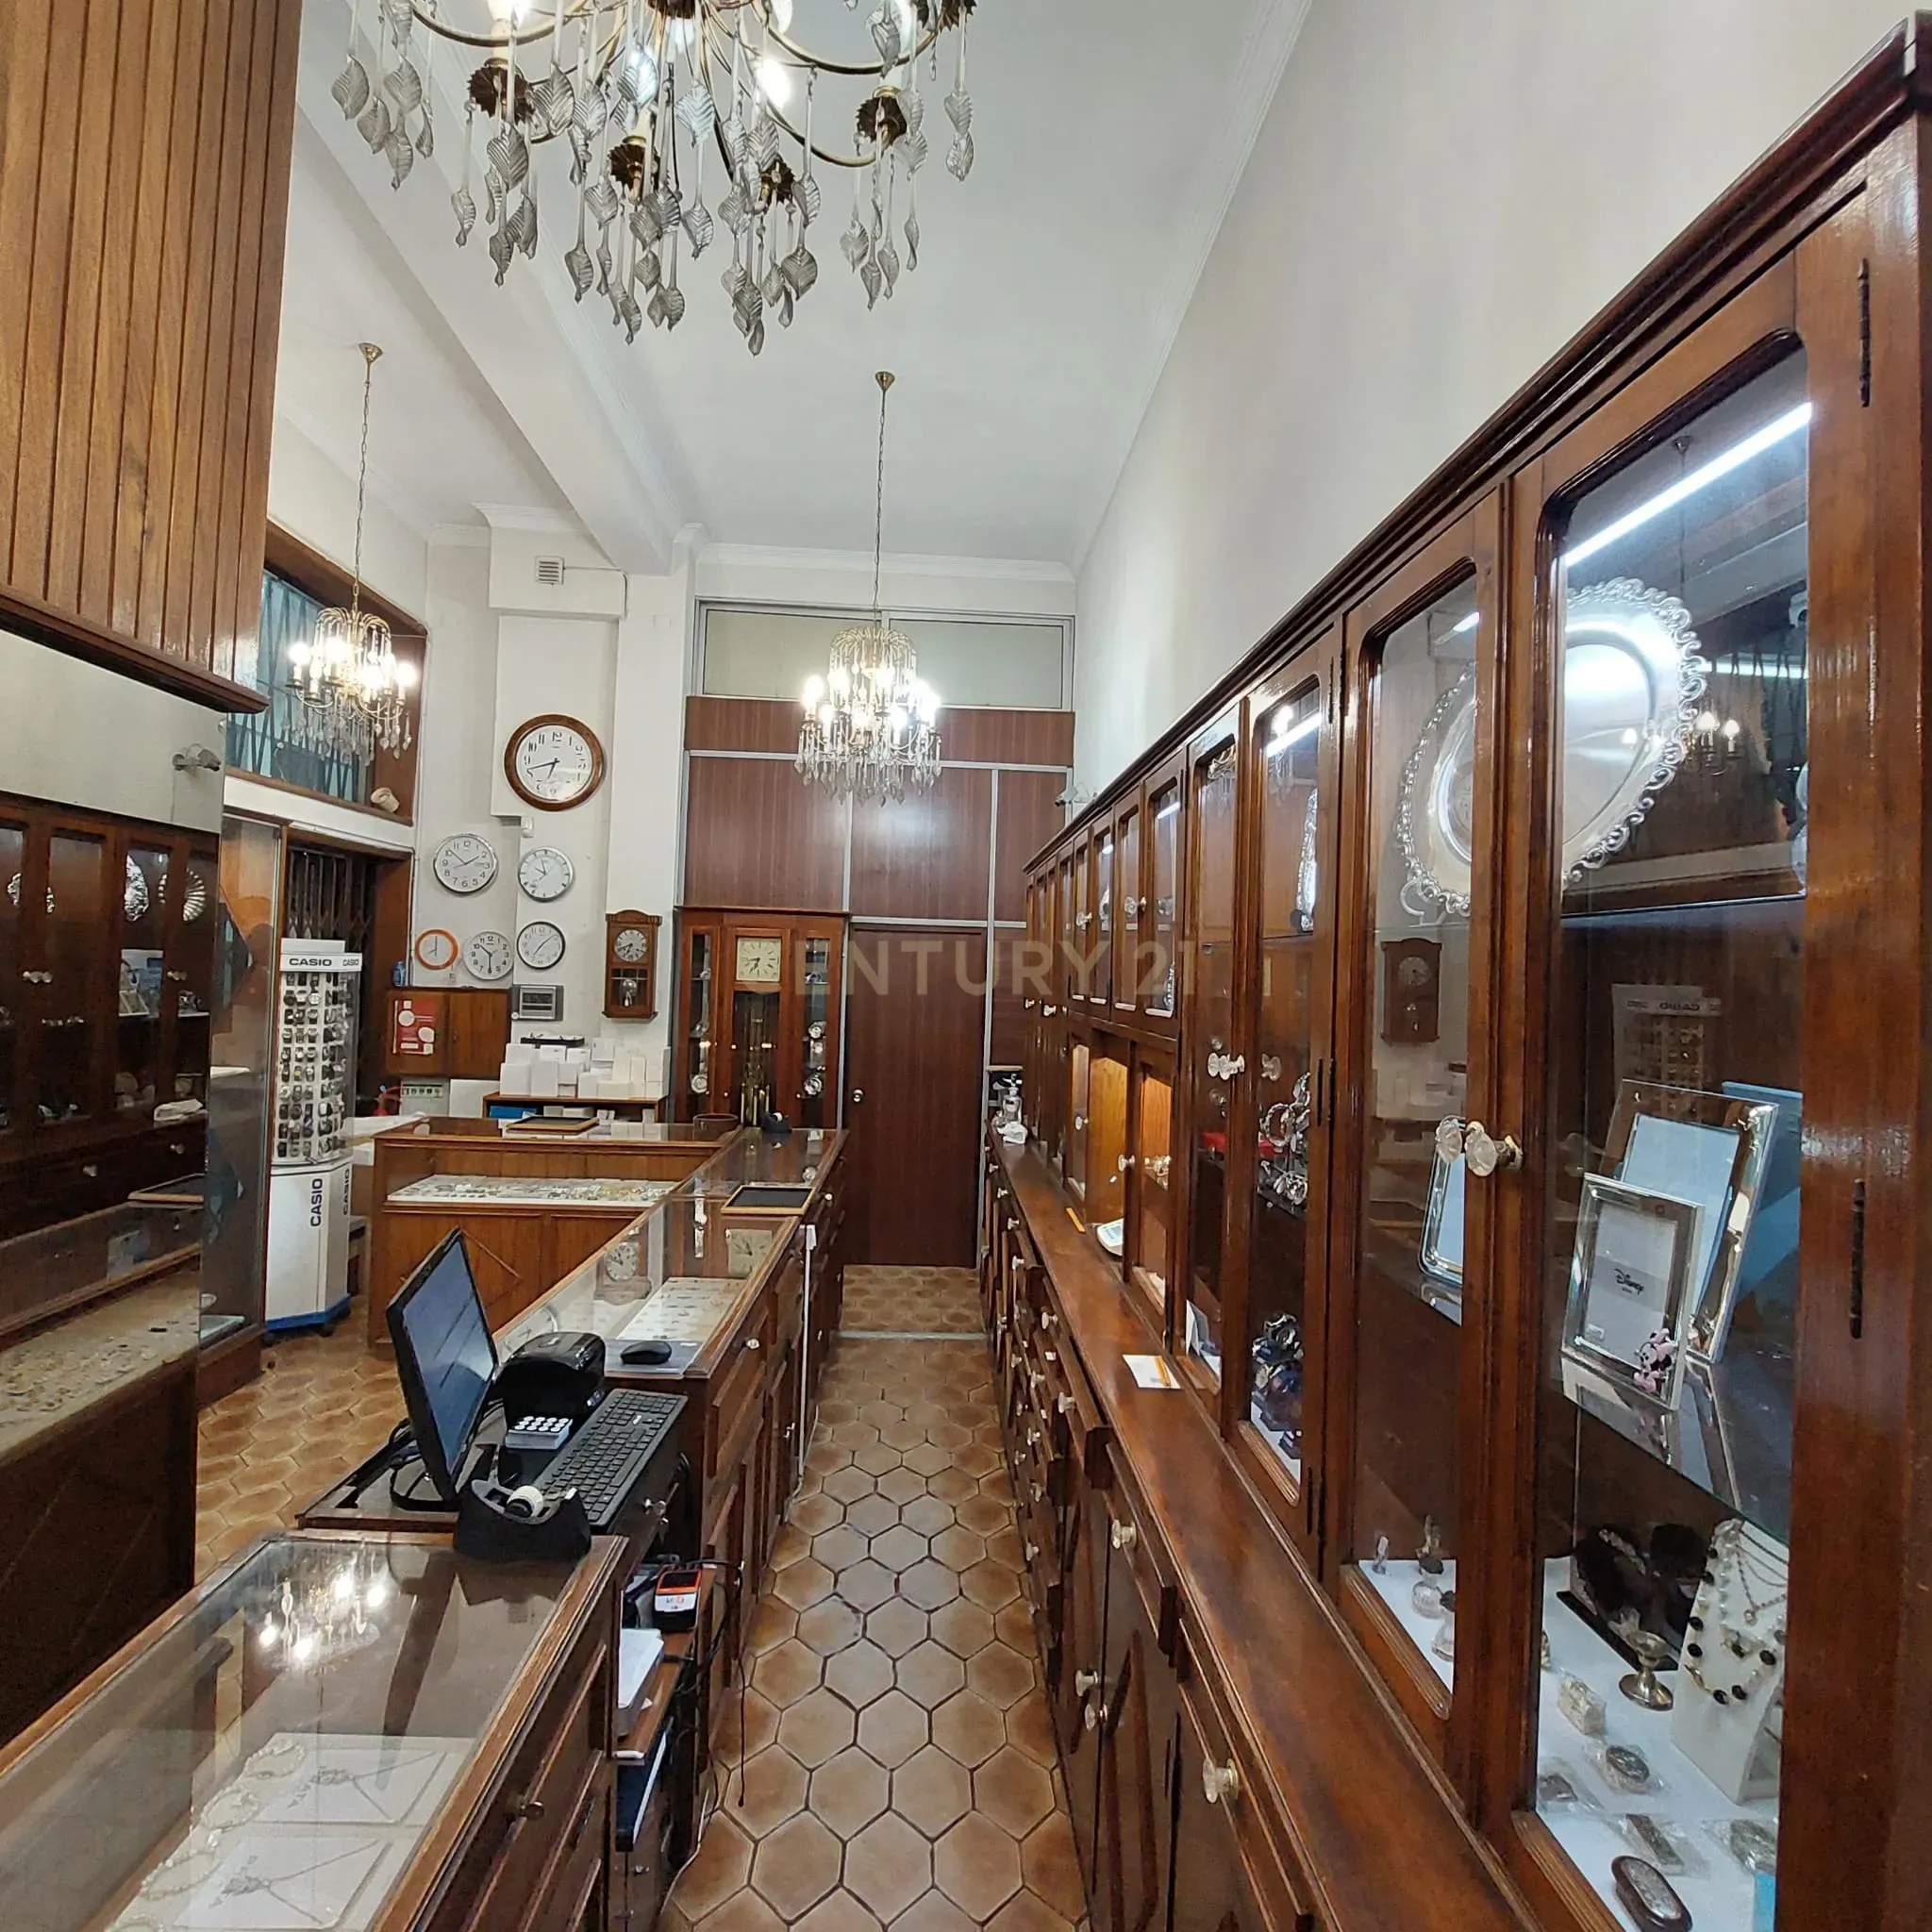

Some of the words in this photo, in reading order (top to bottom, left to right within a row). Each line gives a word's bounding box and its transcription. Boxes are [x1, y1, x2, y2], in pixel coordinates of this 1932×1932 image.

[289, 958, 332, 967] CASIO
[342, 958, 359, 967] CASIO
[310, 1178, 323, 1226] CASIO
[1614, 1268, 1644, 1296] Disney
